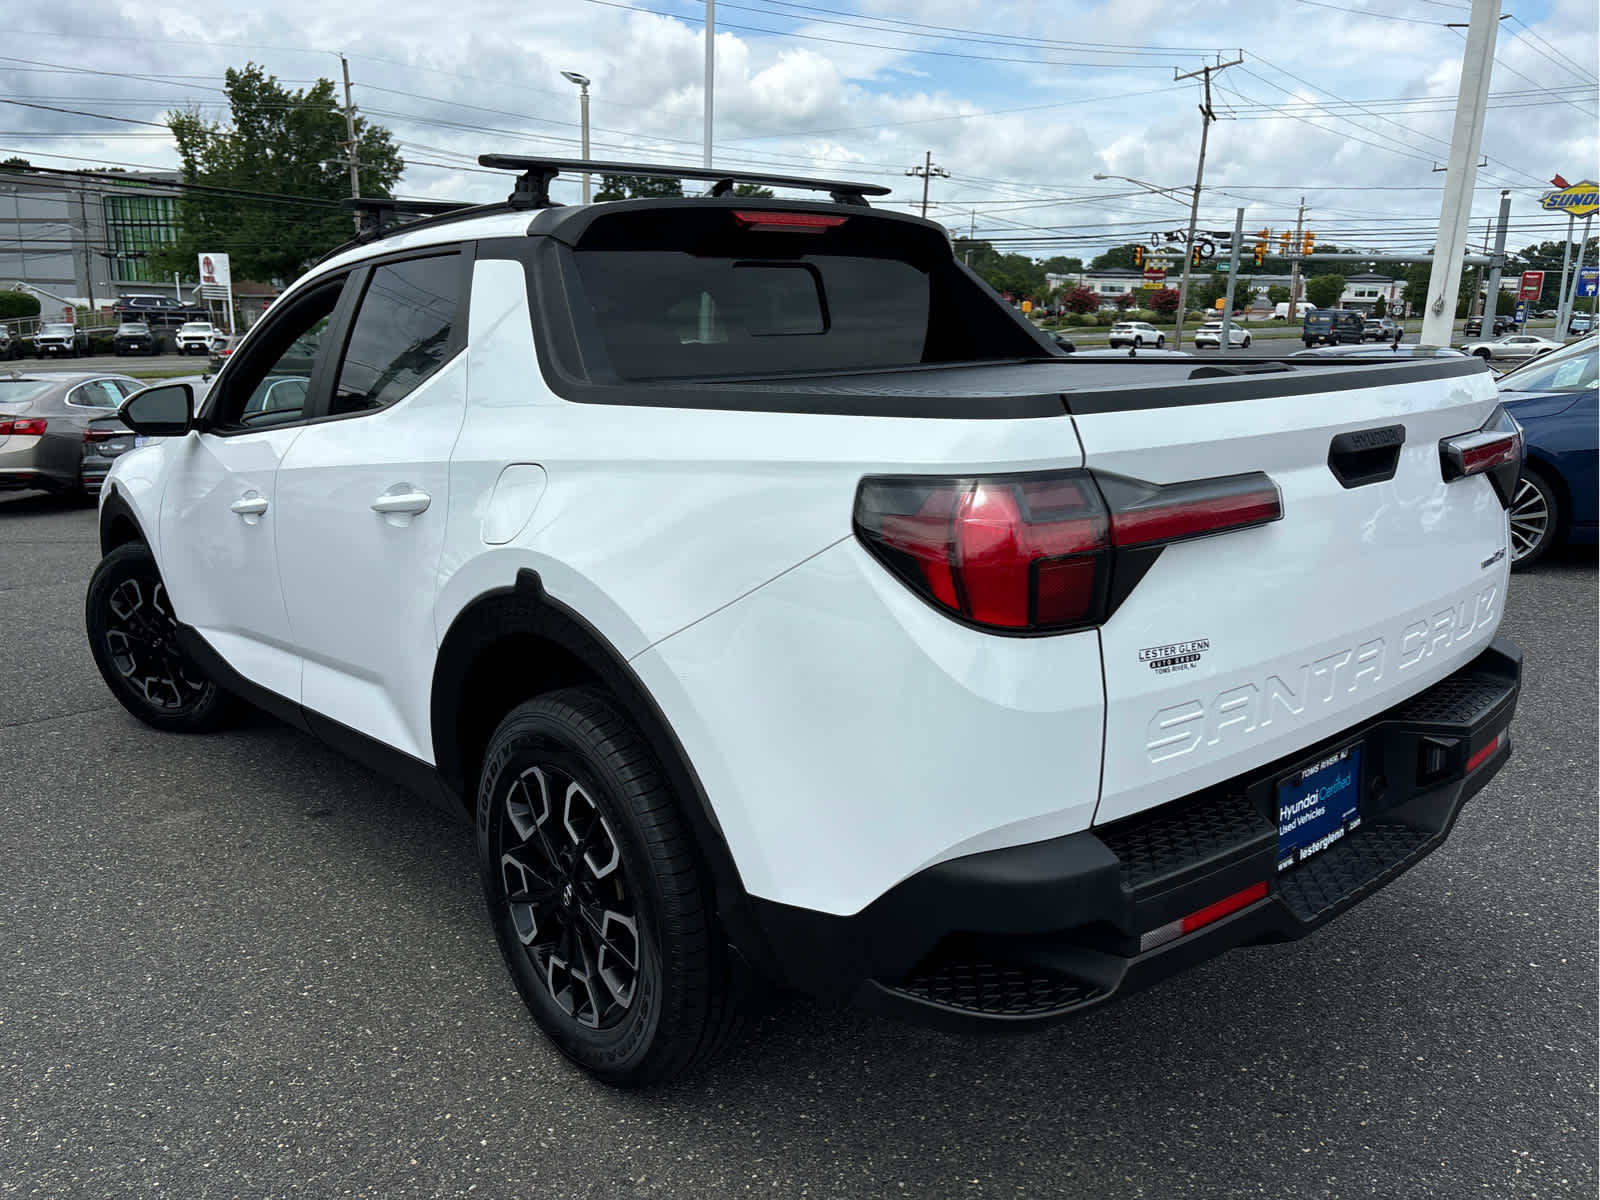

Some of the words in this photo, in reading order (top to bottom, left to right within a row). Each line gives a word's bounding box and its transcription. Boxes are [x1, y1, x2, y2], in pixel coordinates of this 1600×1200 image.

[1352, 429, 1400, 448] HYUNDAI
[1139, 646, 1176, 660] LESTER
[1179, 640, 1209, 653] GLENN
[1151, 660, 1171, 668] AUTO
[1175, 654, 1200, 664] GROUP
[1147, 637, 1386, 763] SANTA
[1399, 584, 1497, 669] CRUZ
[1155, 666, 1170, 675] TOMS
[1280, 789, 1319, 821] Hyundai
[1319, 771, 1351, 801] Certified
[1279, 820, 1297, 836] Used
[1297, 806, 1326, 826] Vehicles
[1300, 828, 1344, 860] lesterglenn
